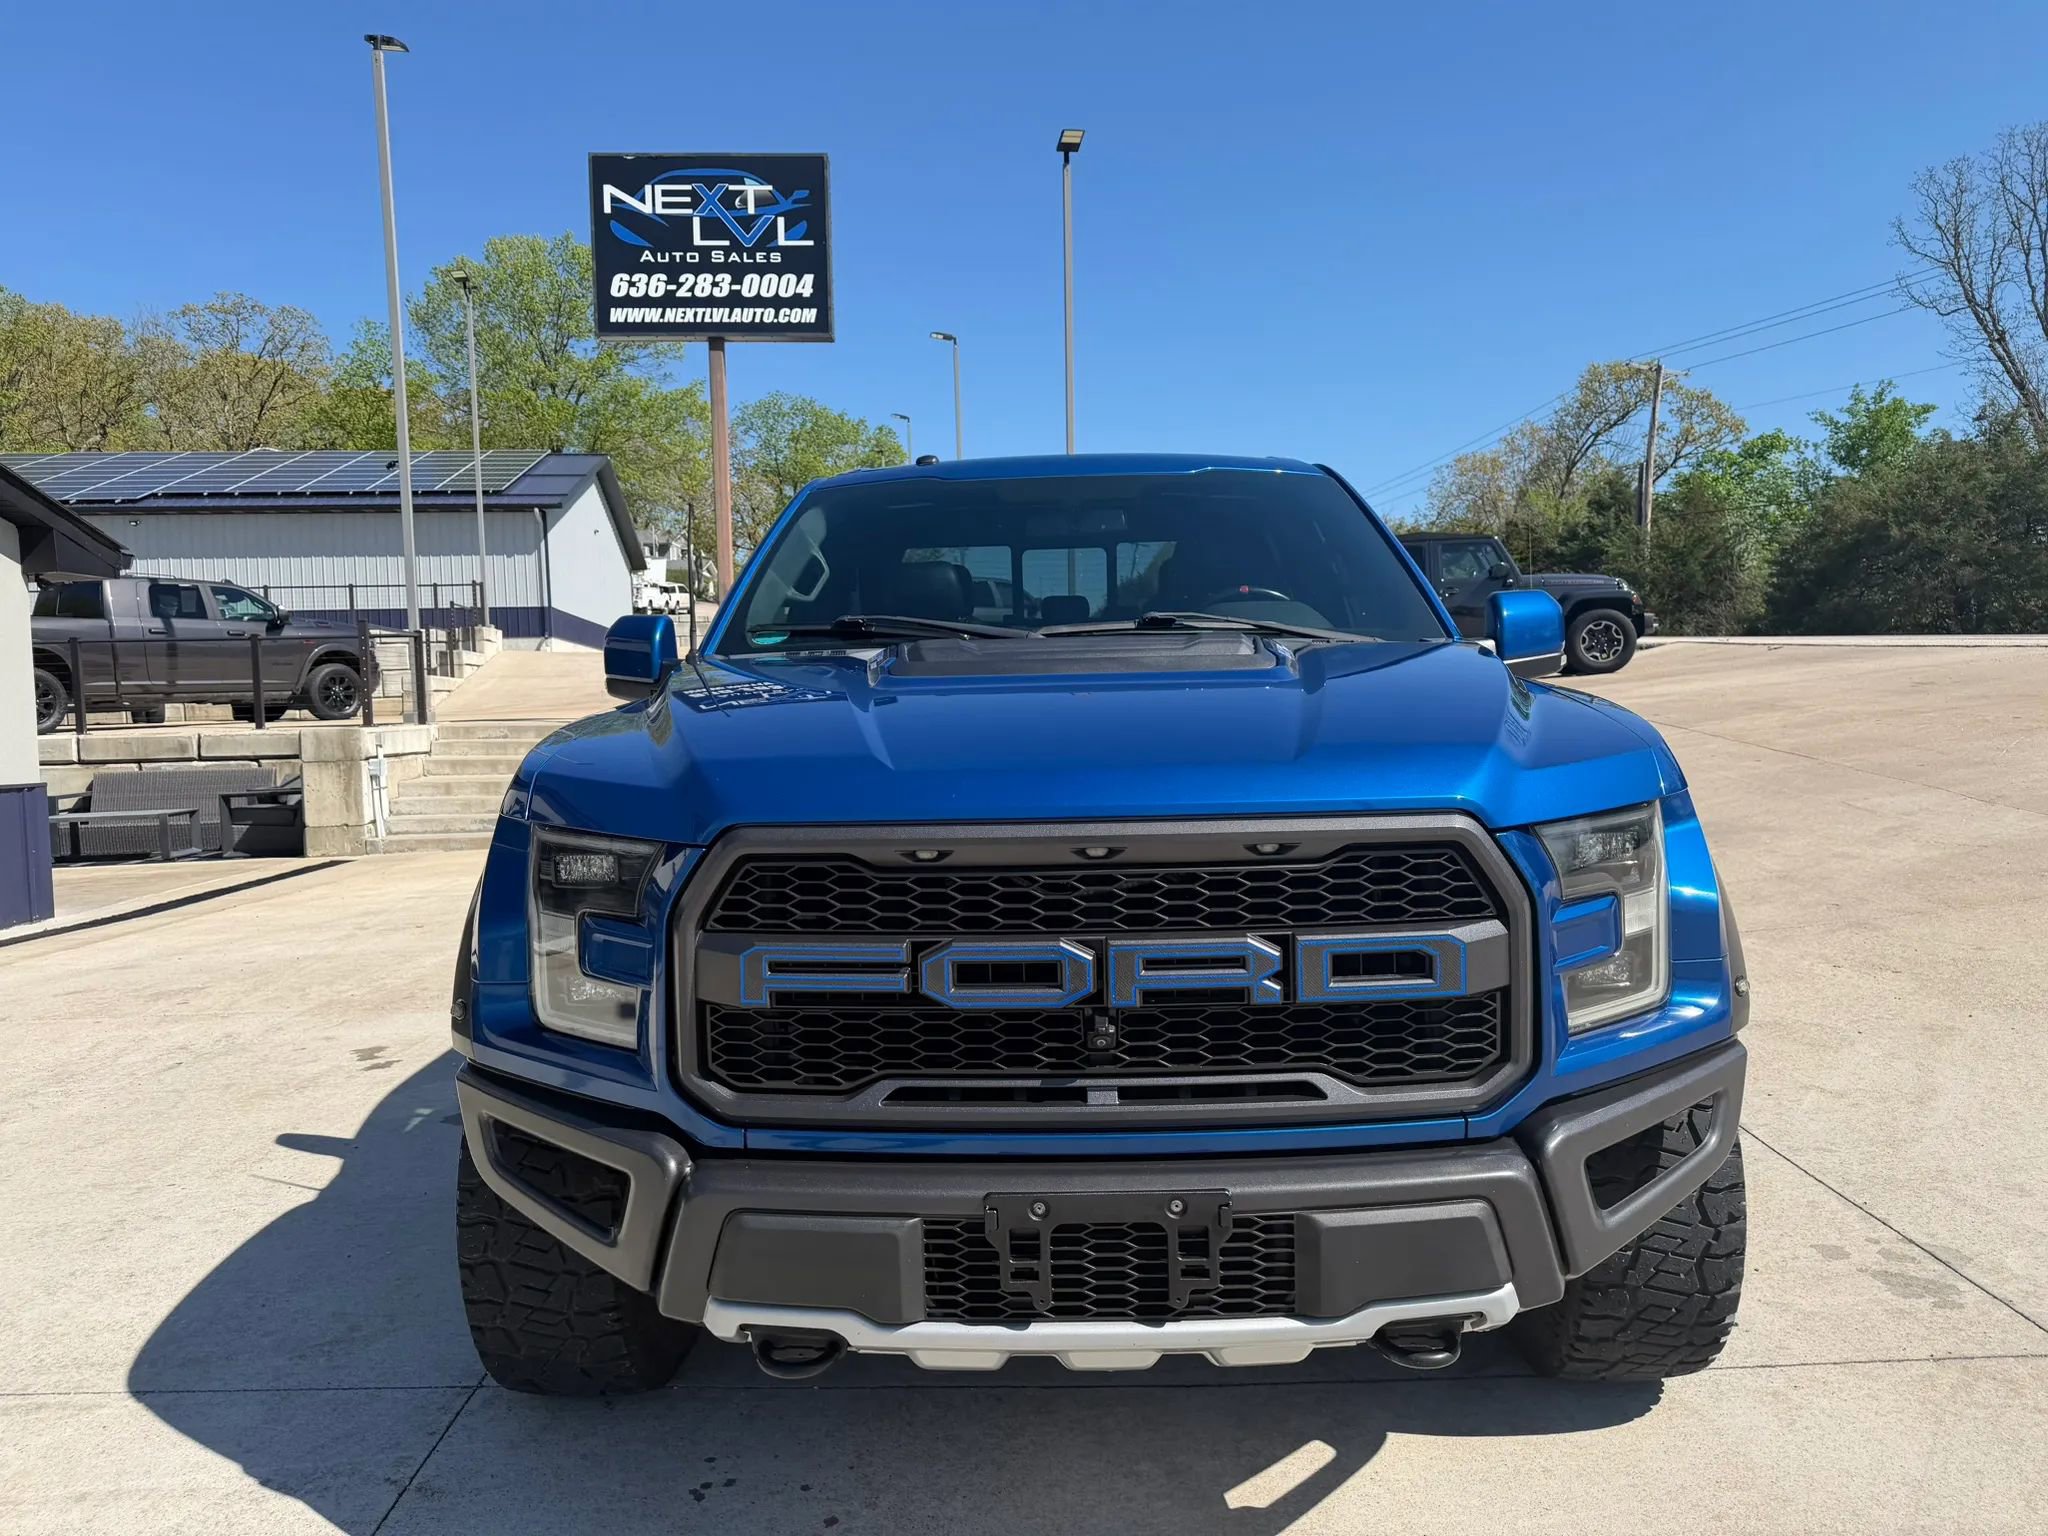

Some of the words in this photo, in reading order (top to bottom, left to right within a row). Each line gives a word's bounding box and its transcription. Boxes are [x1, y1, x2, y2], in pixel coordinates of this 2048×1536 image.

[603, 183, 773, 216] NEXT
[692, 215, 814, 247] LVL
[610, 273, 814, 298] 636-283-0004
[609, 307, 818, 323] WWW.NEXTLVLAUTO.COM
[740, 935, 1468, 1009] FORD
